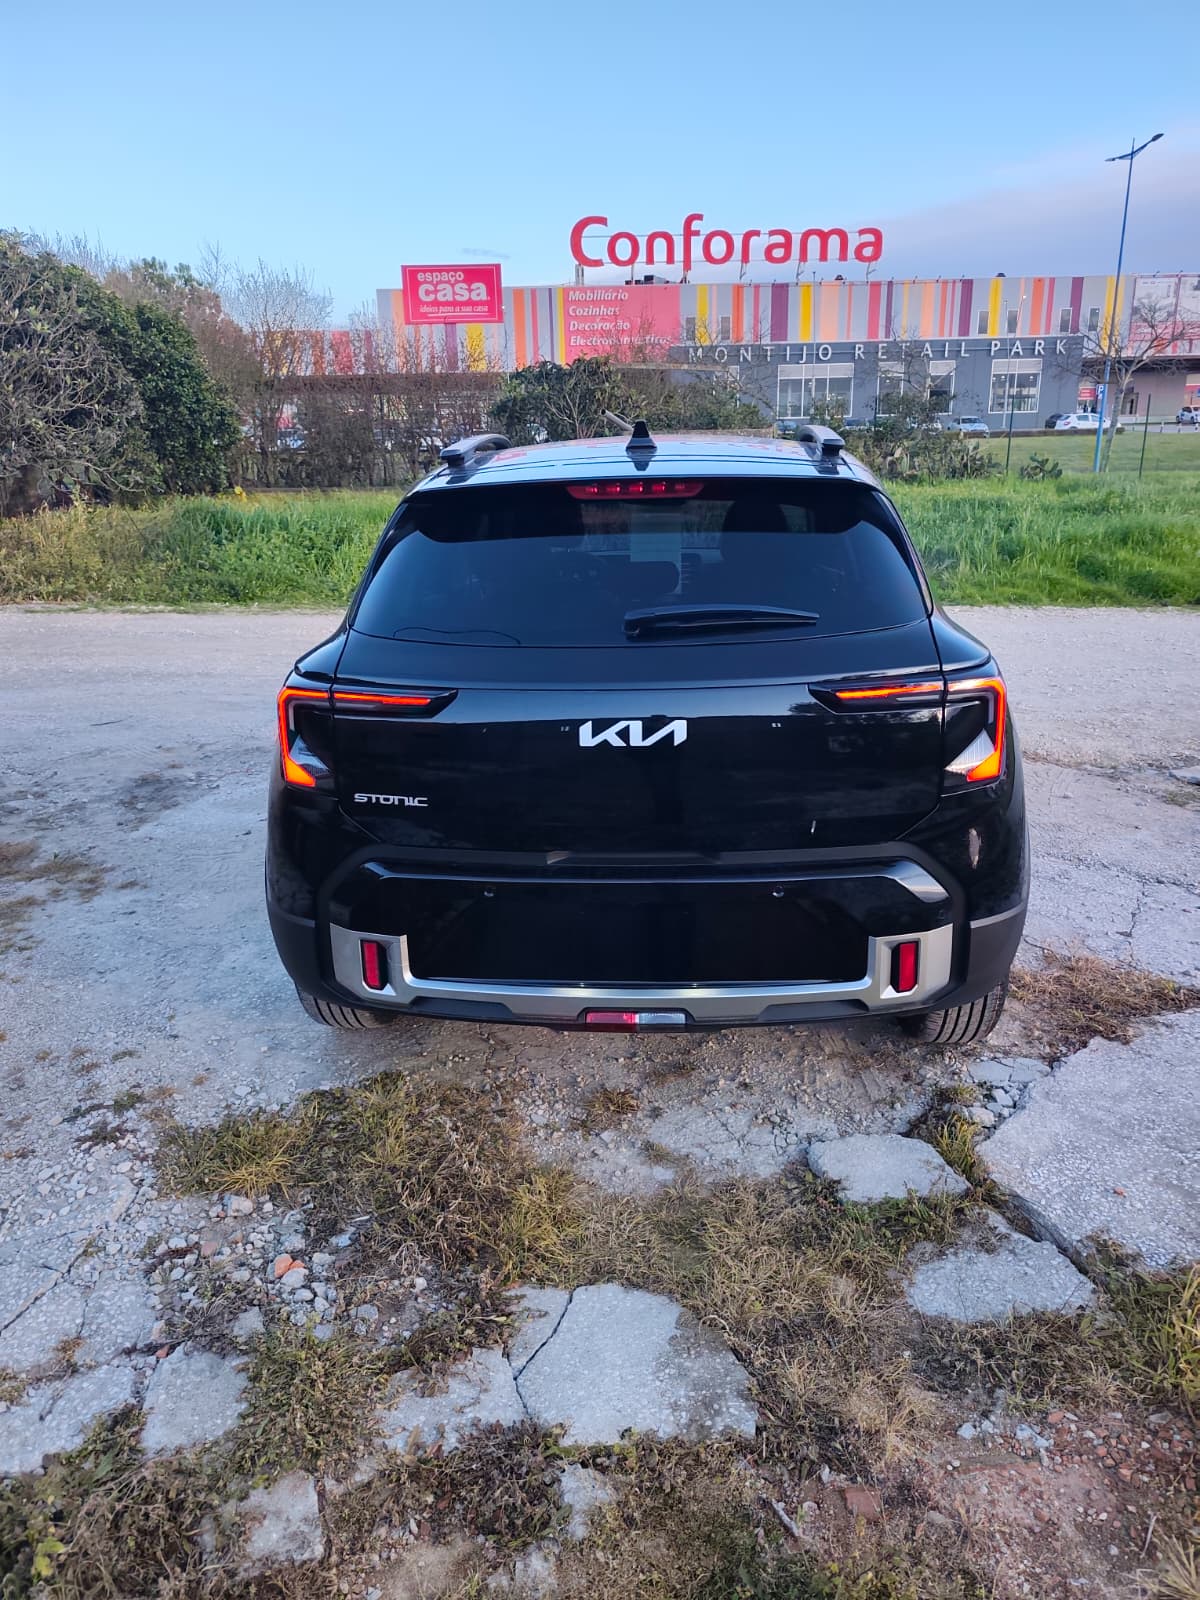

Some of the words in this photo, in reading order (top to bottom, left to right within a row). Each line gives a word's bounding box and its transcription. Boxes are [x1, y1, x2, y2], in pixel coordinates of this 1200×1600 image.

[570, 213, 883, 272] Conforama
[417, 271, 464, 284] espaço
[418, 282, 488, 301] casa
[568, 289, 629, 301] Mobiliário
[568, 305, 620, 316] Cozinhas
[569, 319, 631, 332] Decoração
[688, 344, 832, 364] MONTIJO
[854, 341, 970, 360] RETAIL
[990, 339, 1067, 357] PARK
[579, 720, 687, 747] KIA
[354, 793, 428, 807] STONIC
